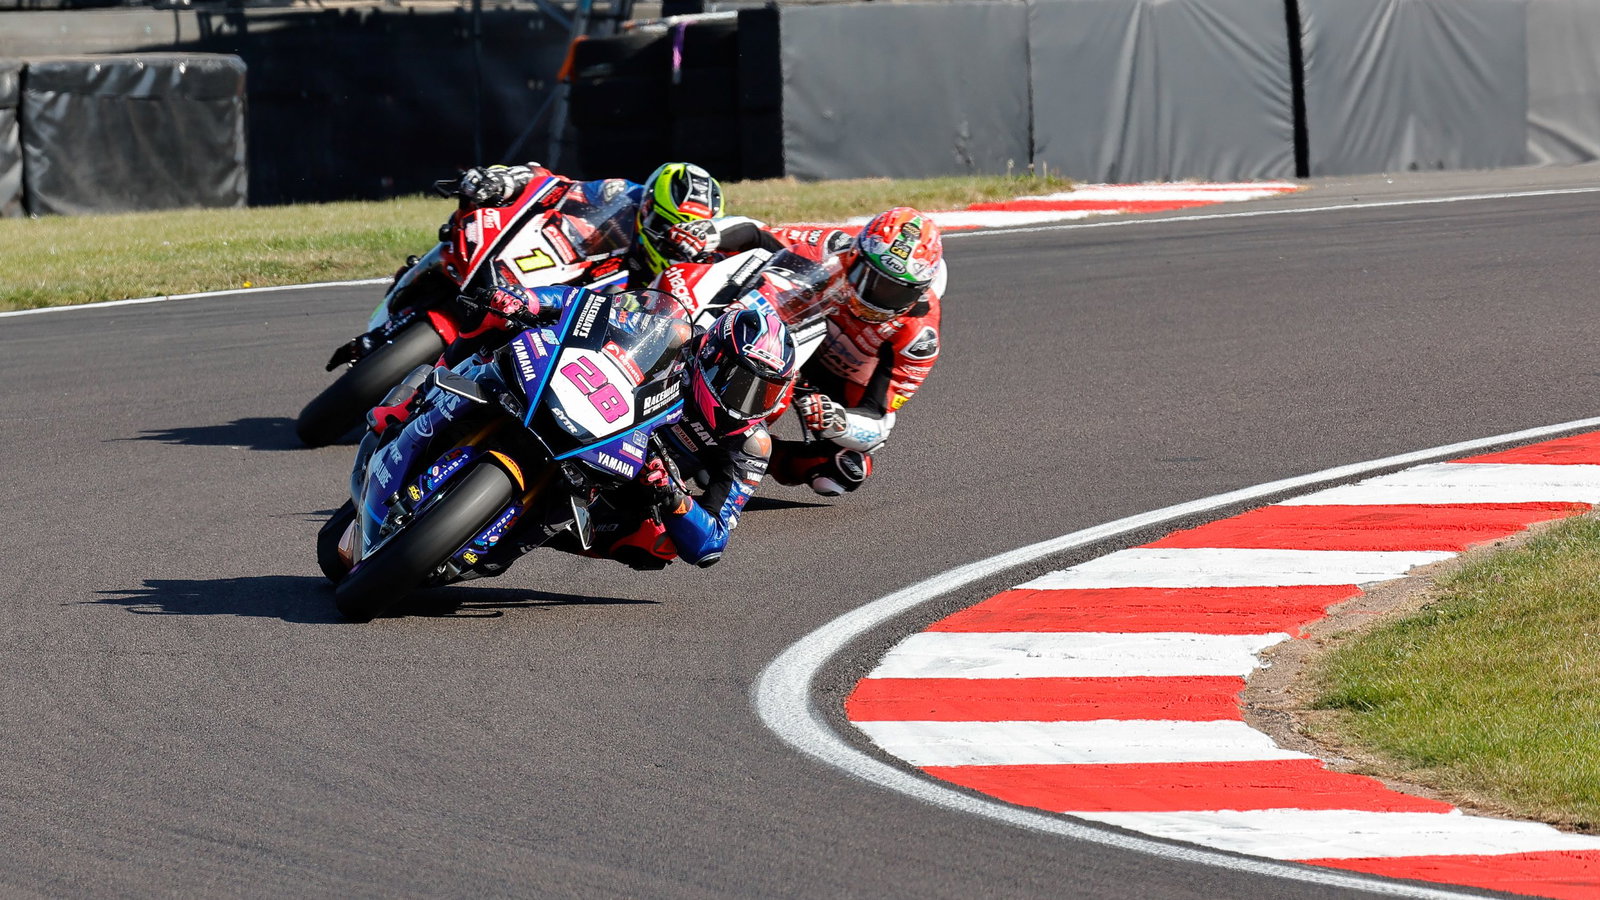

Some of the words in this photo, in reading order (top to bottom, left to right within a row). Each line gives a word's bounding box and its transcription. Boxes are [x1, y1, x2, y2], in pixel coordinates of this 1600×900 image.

[514, 247, 557, 274] 1
[884, 256, 904, 273] Arai
[666, 267, 697, 314] hager
[579, 294, 607, 339] RACEWAYS
[512, 339, 537, 382] YAMAHA
[560, 355, 630, 424] 28
[644, 380, 681, 409] RACEWAYS
[551, 407, 579, 434] GYTR
[690, 421, 718, 447] RAY
[632, 430, 649, 448] 28
[678, 430, 698, 452] YAMAHA
[433, 454, 469, 484] PIRELLI
[597, 451, 635, 478] YAMAHA
[482, 509, 515, 540] PIRELLI
